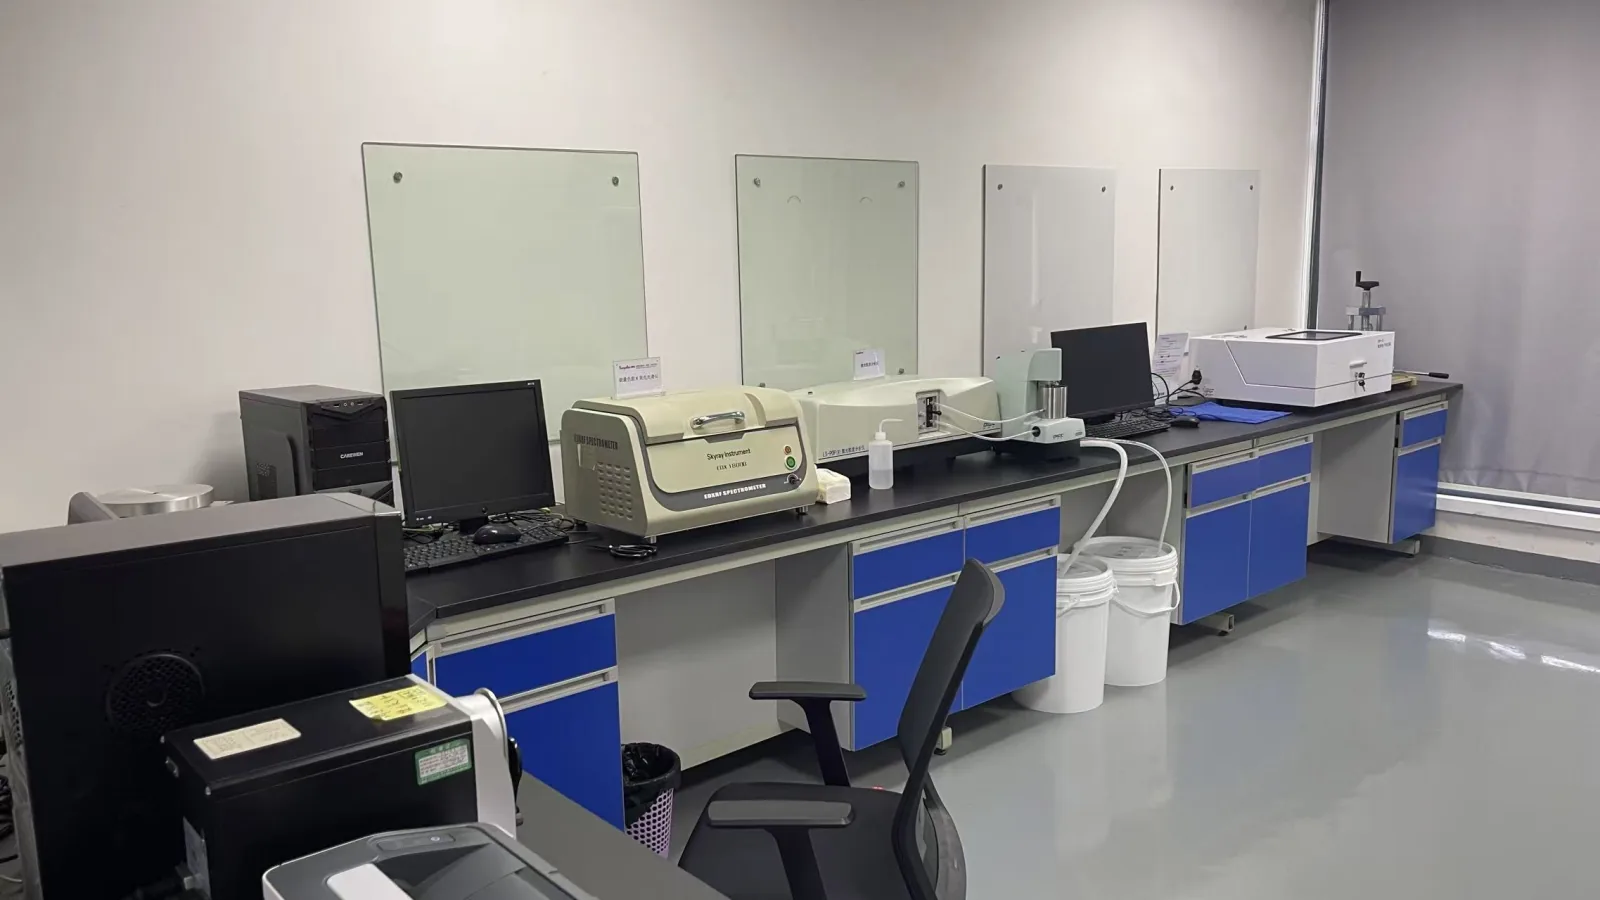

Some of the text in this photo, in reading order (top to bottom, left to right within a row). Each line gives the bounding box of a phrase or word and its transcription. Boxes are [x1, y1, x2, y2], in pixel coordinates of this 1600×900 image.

[706, 448, 751, 460] Skyray Instrument
[722, 483, 767, 496] SPECTROMETER
